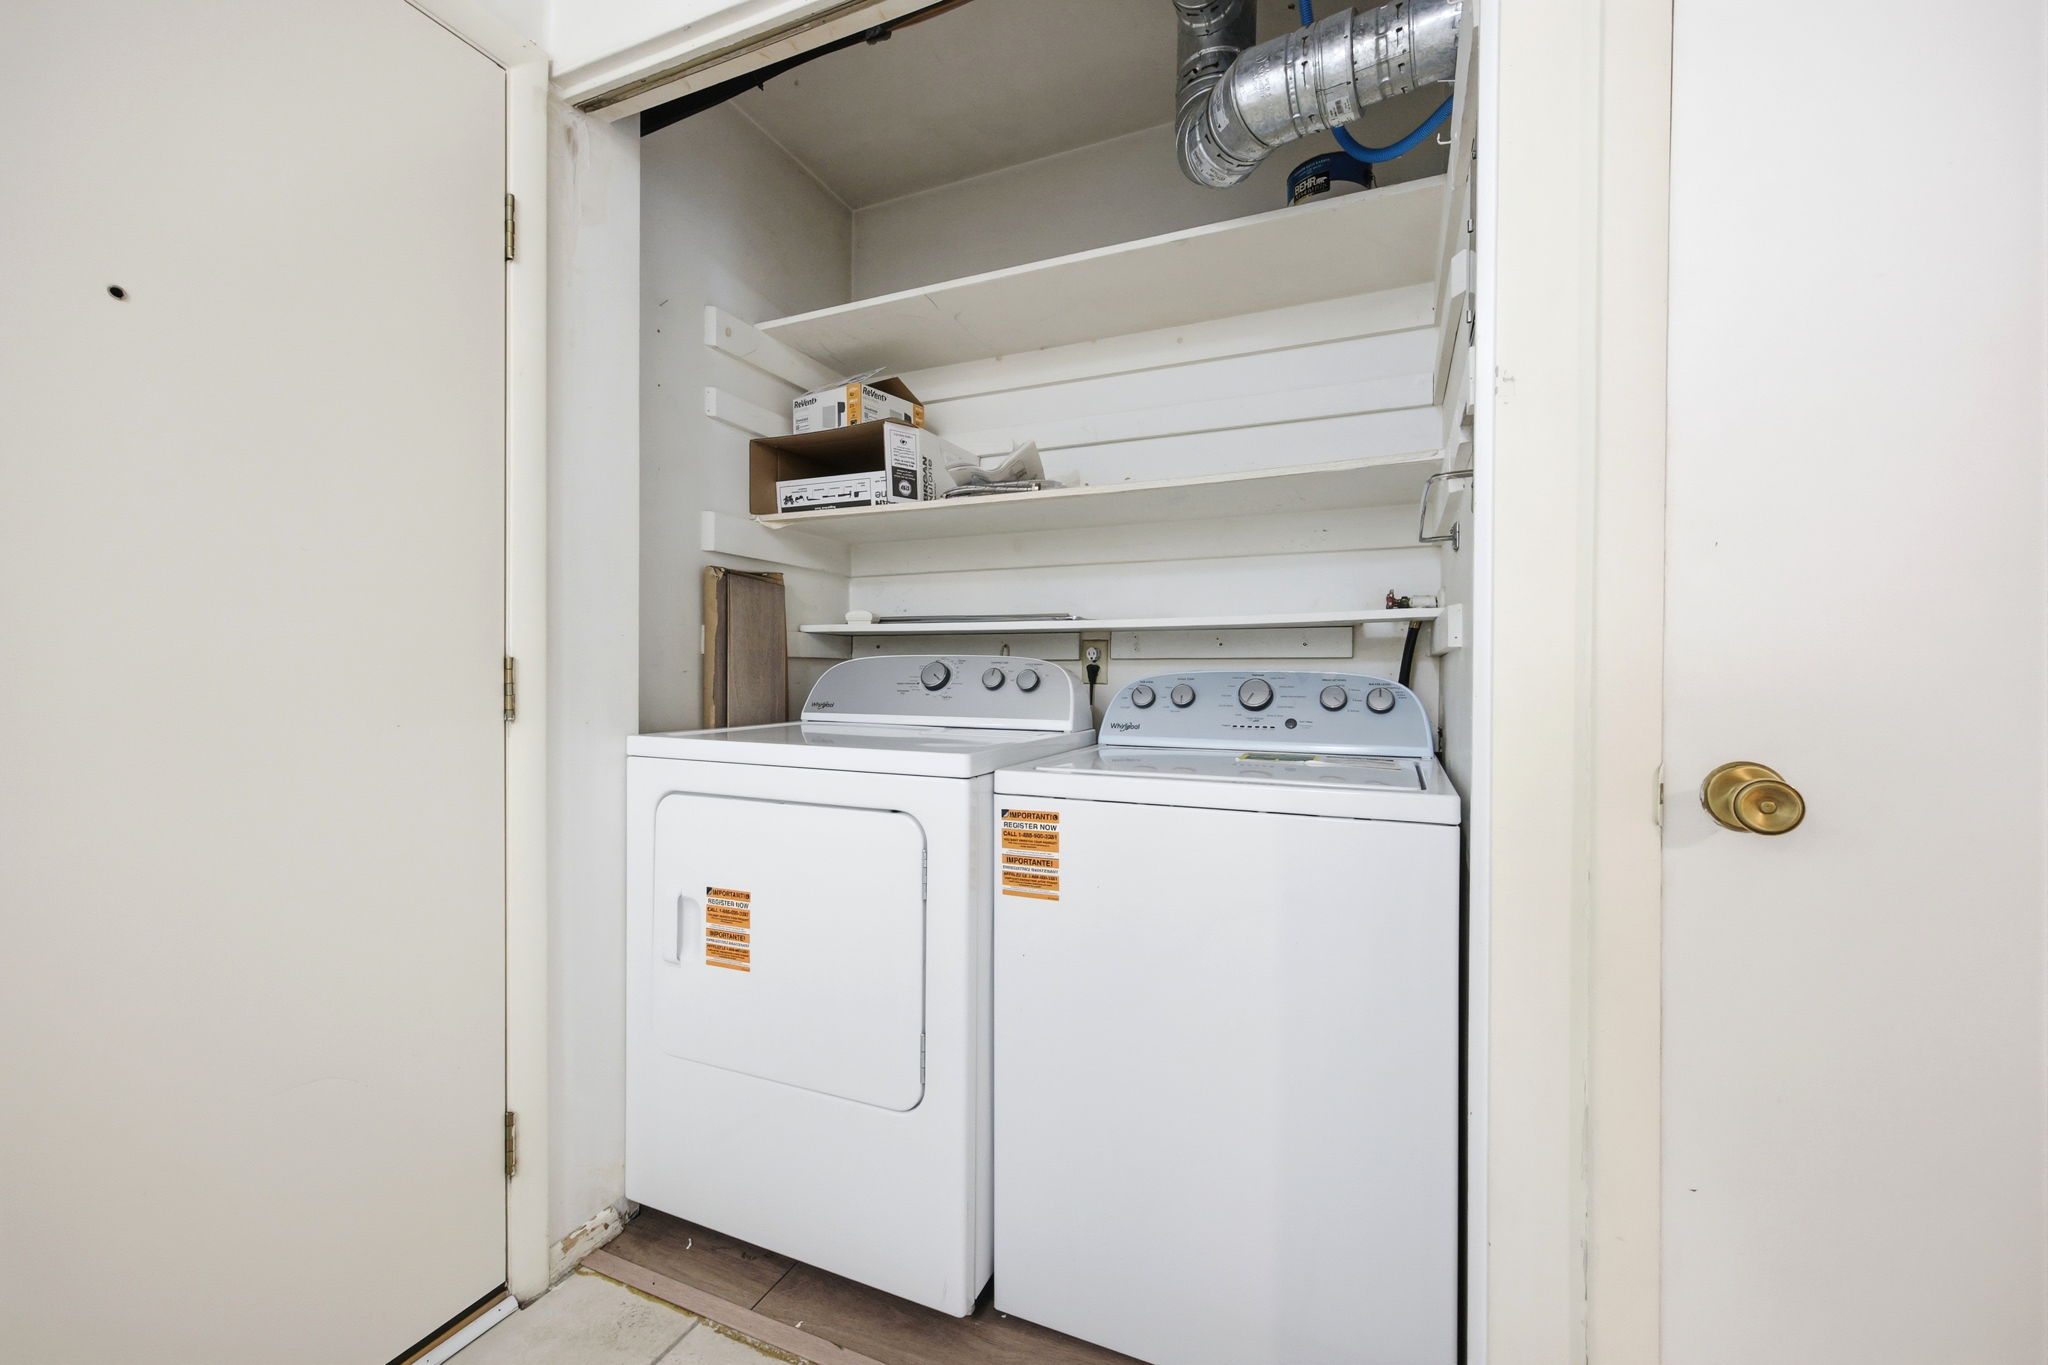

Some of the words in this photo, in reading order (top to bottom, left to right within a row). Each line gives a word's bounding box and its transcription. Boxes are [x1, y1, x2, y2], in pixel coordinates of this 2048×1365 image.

[1294, 176, 1317, 195] BEHR
[811, 701, 835, 710] Whirlpool
[1110, 722, 1141, 732] Whirlpool
[1003, 821, 1038, 830] REGISTER
[1003, 830, 1017, 838] CALL
[1006, 857, 1053, 867] IMPORTANTE!
[707, 898, 735, 907] REGISTER
